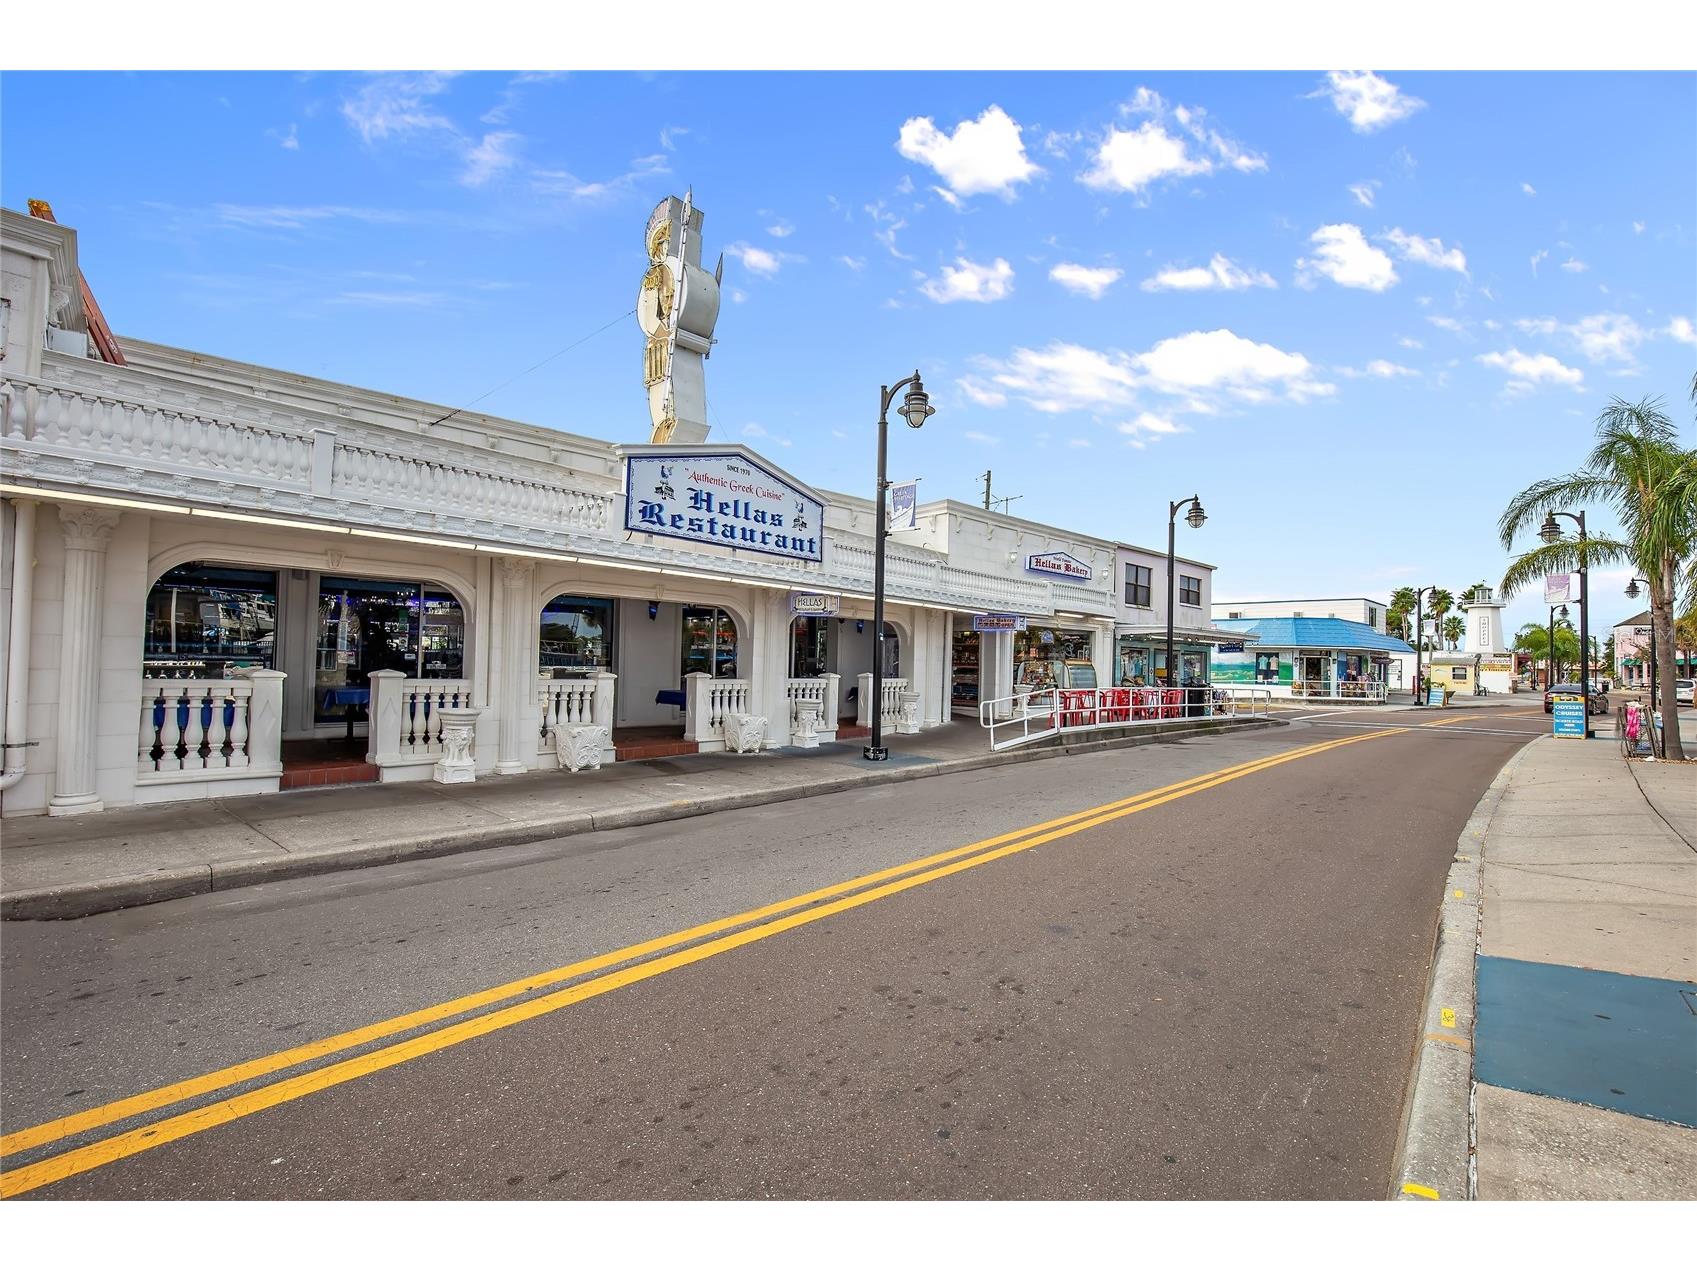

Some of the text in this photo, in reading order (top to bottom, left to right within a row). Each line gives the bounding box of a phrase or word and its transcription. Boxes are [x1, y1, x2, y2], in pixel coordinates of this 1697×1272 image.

[726, 464, 739, 473] SINCE
[729, 480, 754, 495] Greek
[686, 487, 784, 527] Hellas
[638, 500, 817, 554] Restaurant
[1034, 557, 1088, 577] Hellas Bakery
[797, 597, 823, 607] HELLAS
